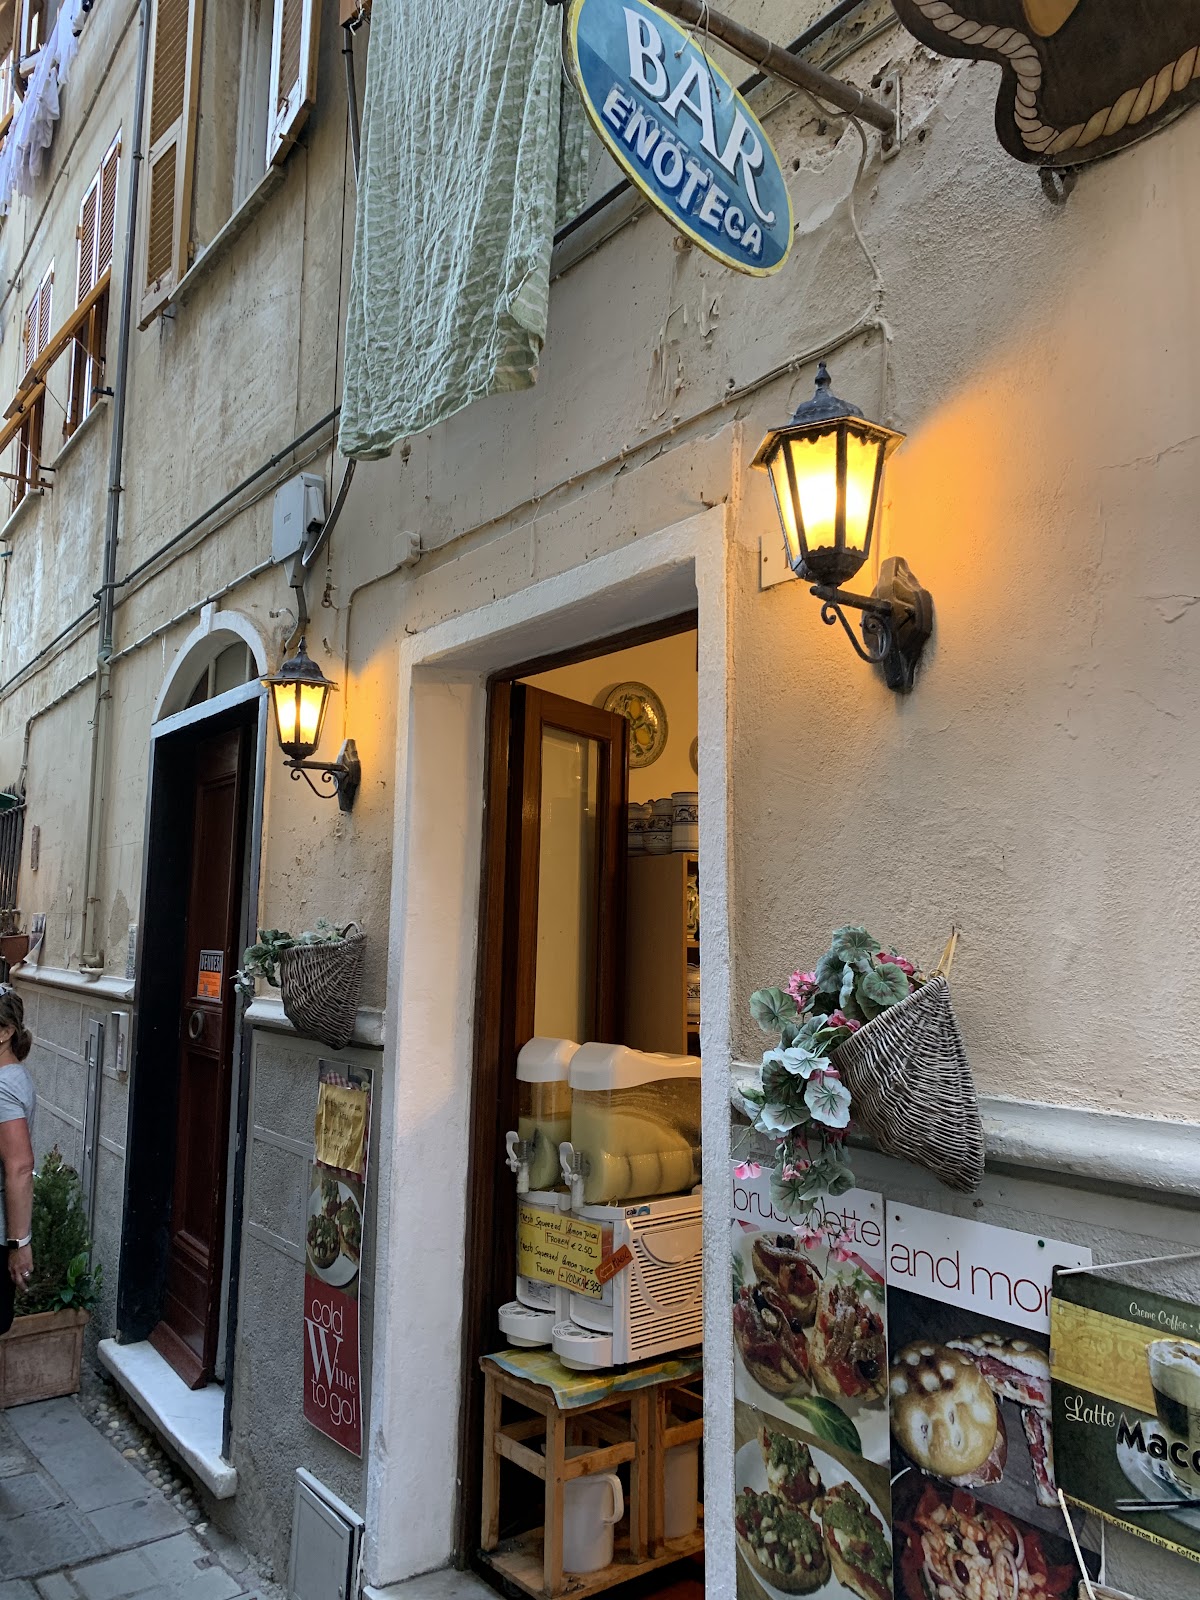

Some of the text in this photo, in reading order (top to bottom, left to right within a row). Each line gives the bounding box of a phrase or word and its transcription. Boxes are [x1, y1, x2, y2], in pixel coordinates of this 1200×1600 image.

[622, 6, 777, 224] BAR
[602, 87, 763, 255] ENOTECA
[732, 1179, 881, 1247] bruette
[890, 1243, 960, 1291] and
[311, 1299, 343, 1336] cold
[1158, 1310, 1188, 1331] Coffee
[304, 1316, 356, 1394] Wine
[311, 1373, 357, 1429] to go!
[1064, 1395, 1116, 1428] Latte
[1112, 1518, 1200, 1562] Coffee from Italy Coffee
